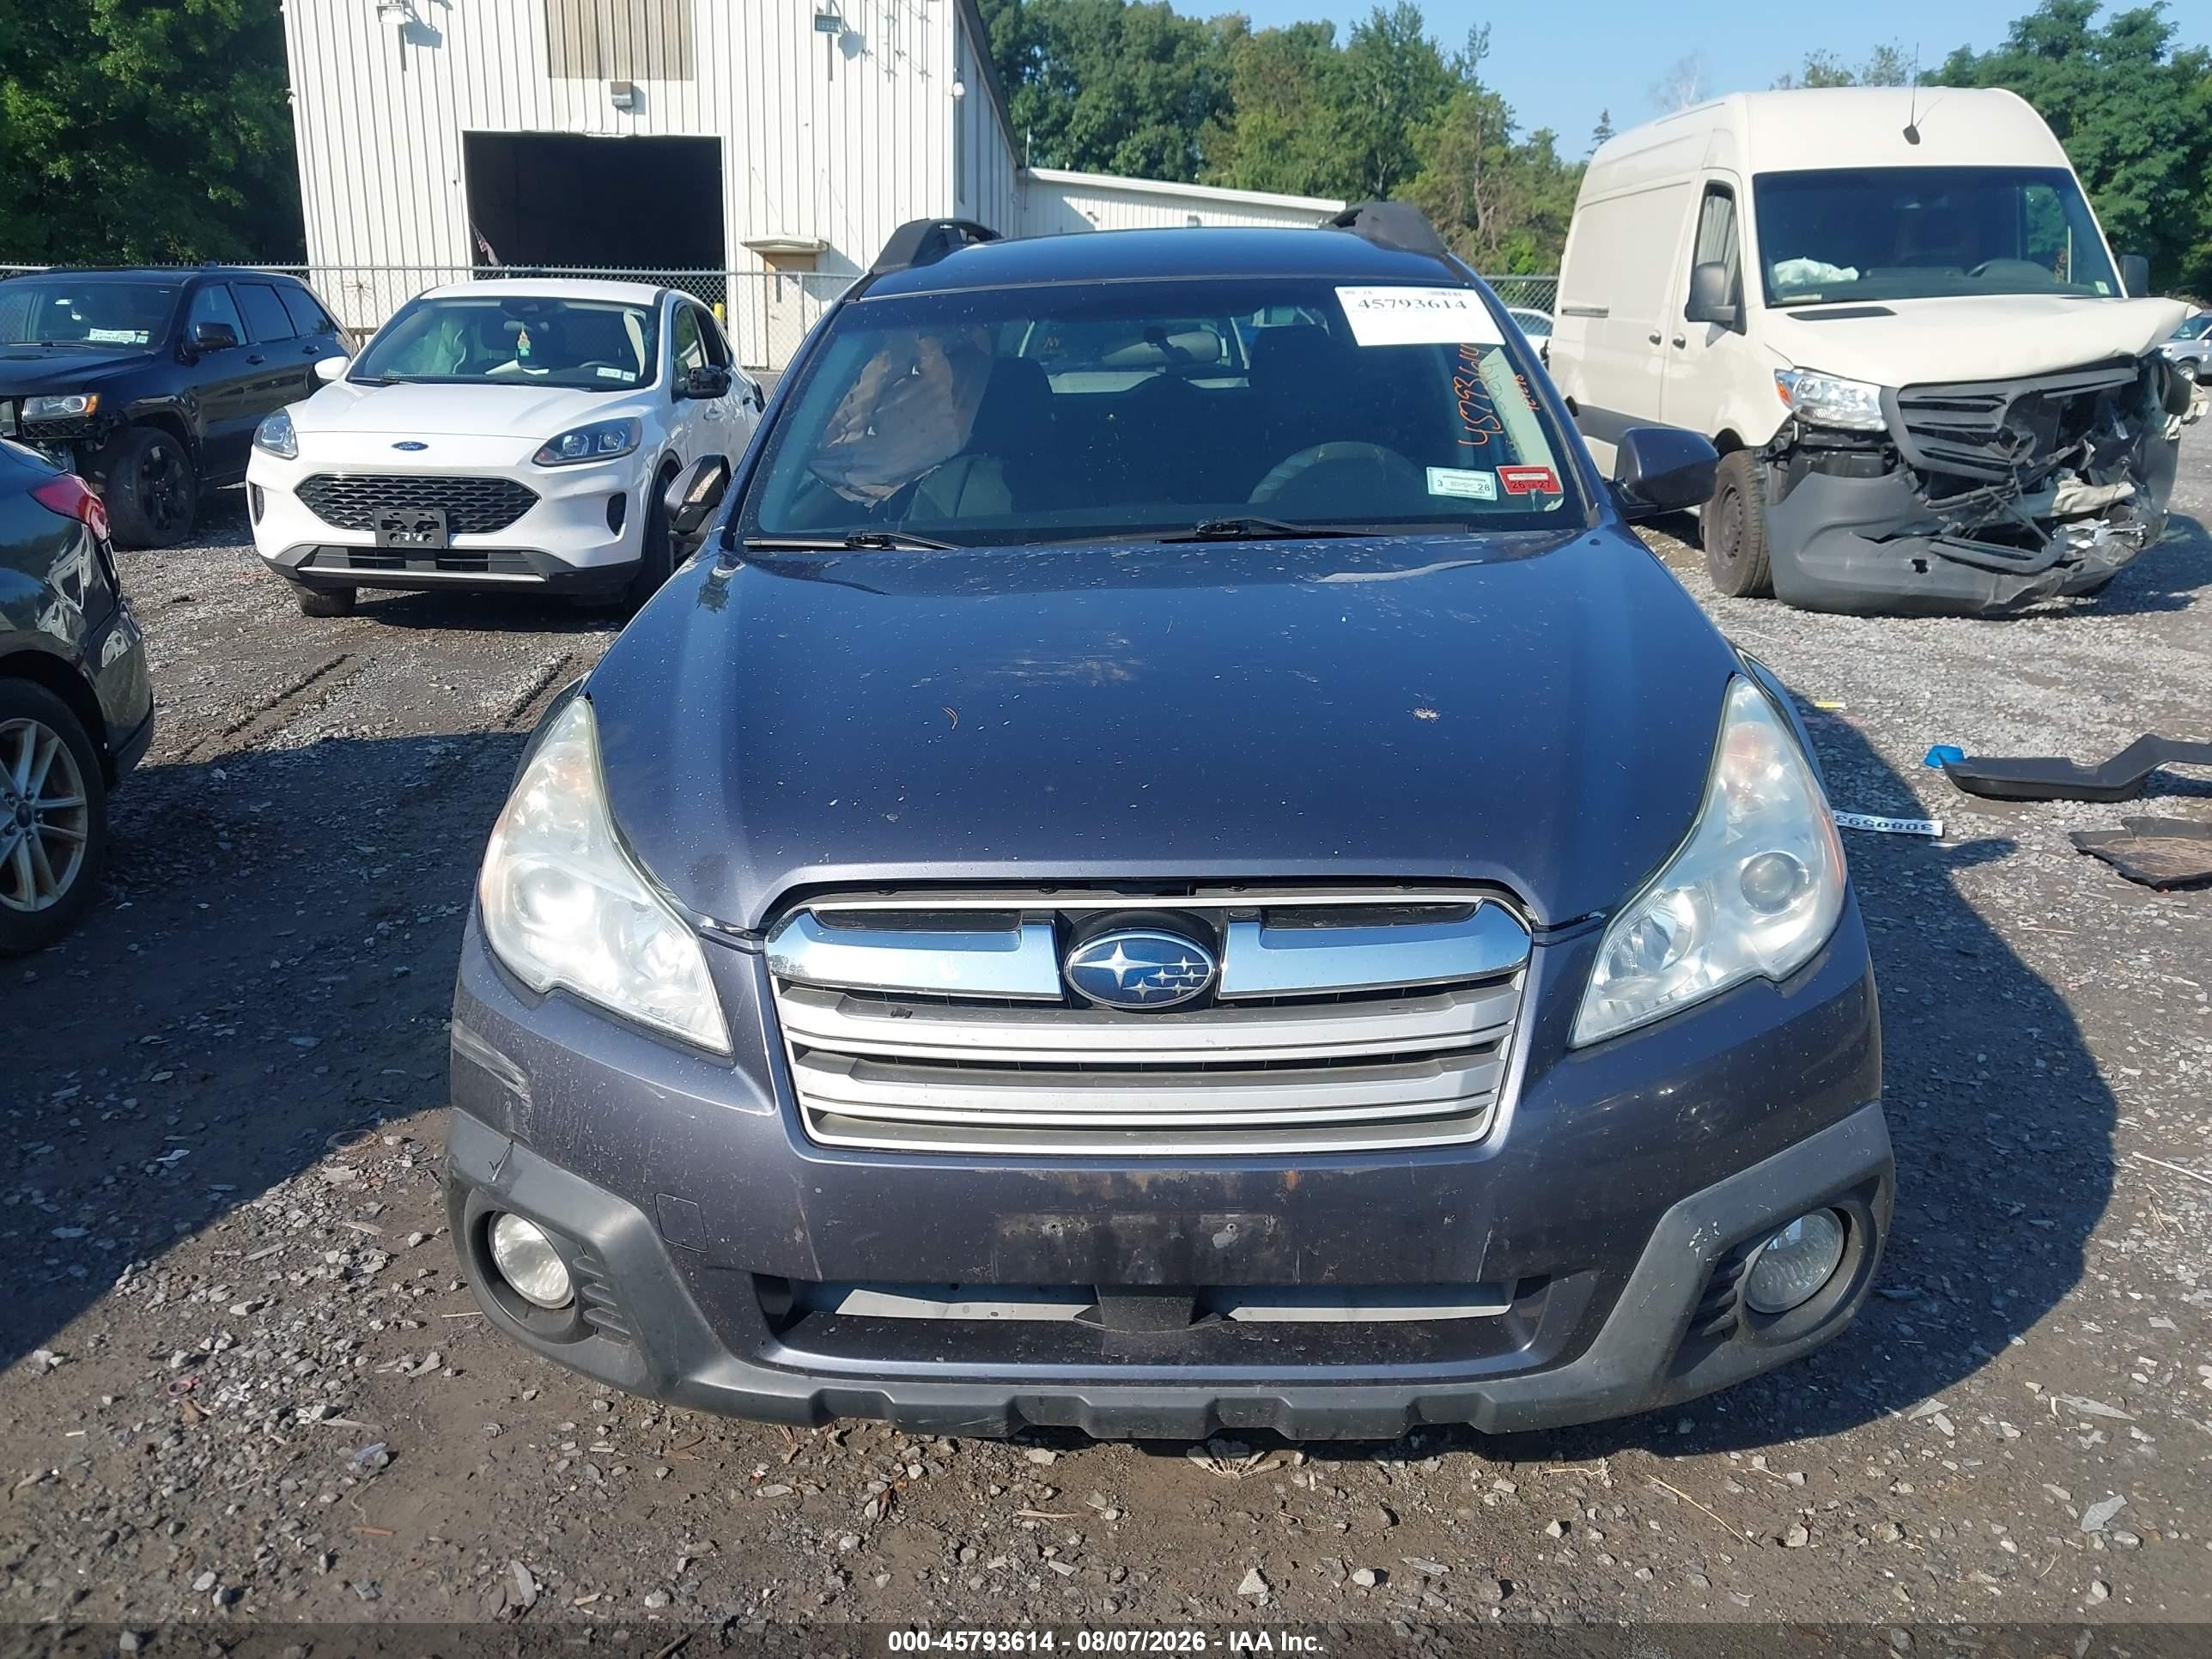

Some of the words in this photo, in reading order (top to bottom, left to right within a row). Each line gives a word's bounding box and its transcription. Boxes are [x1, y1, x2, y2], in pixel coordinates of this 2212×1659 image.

[1358, 299, 1468, 309] 45793614
[1511, 480, 1526, 489] 26
[1538, 480, 1551, 489] 27
